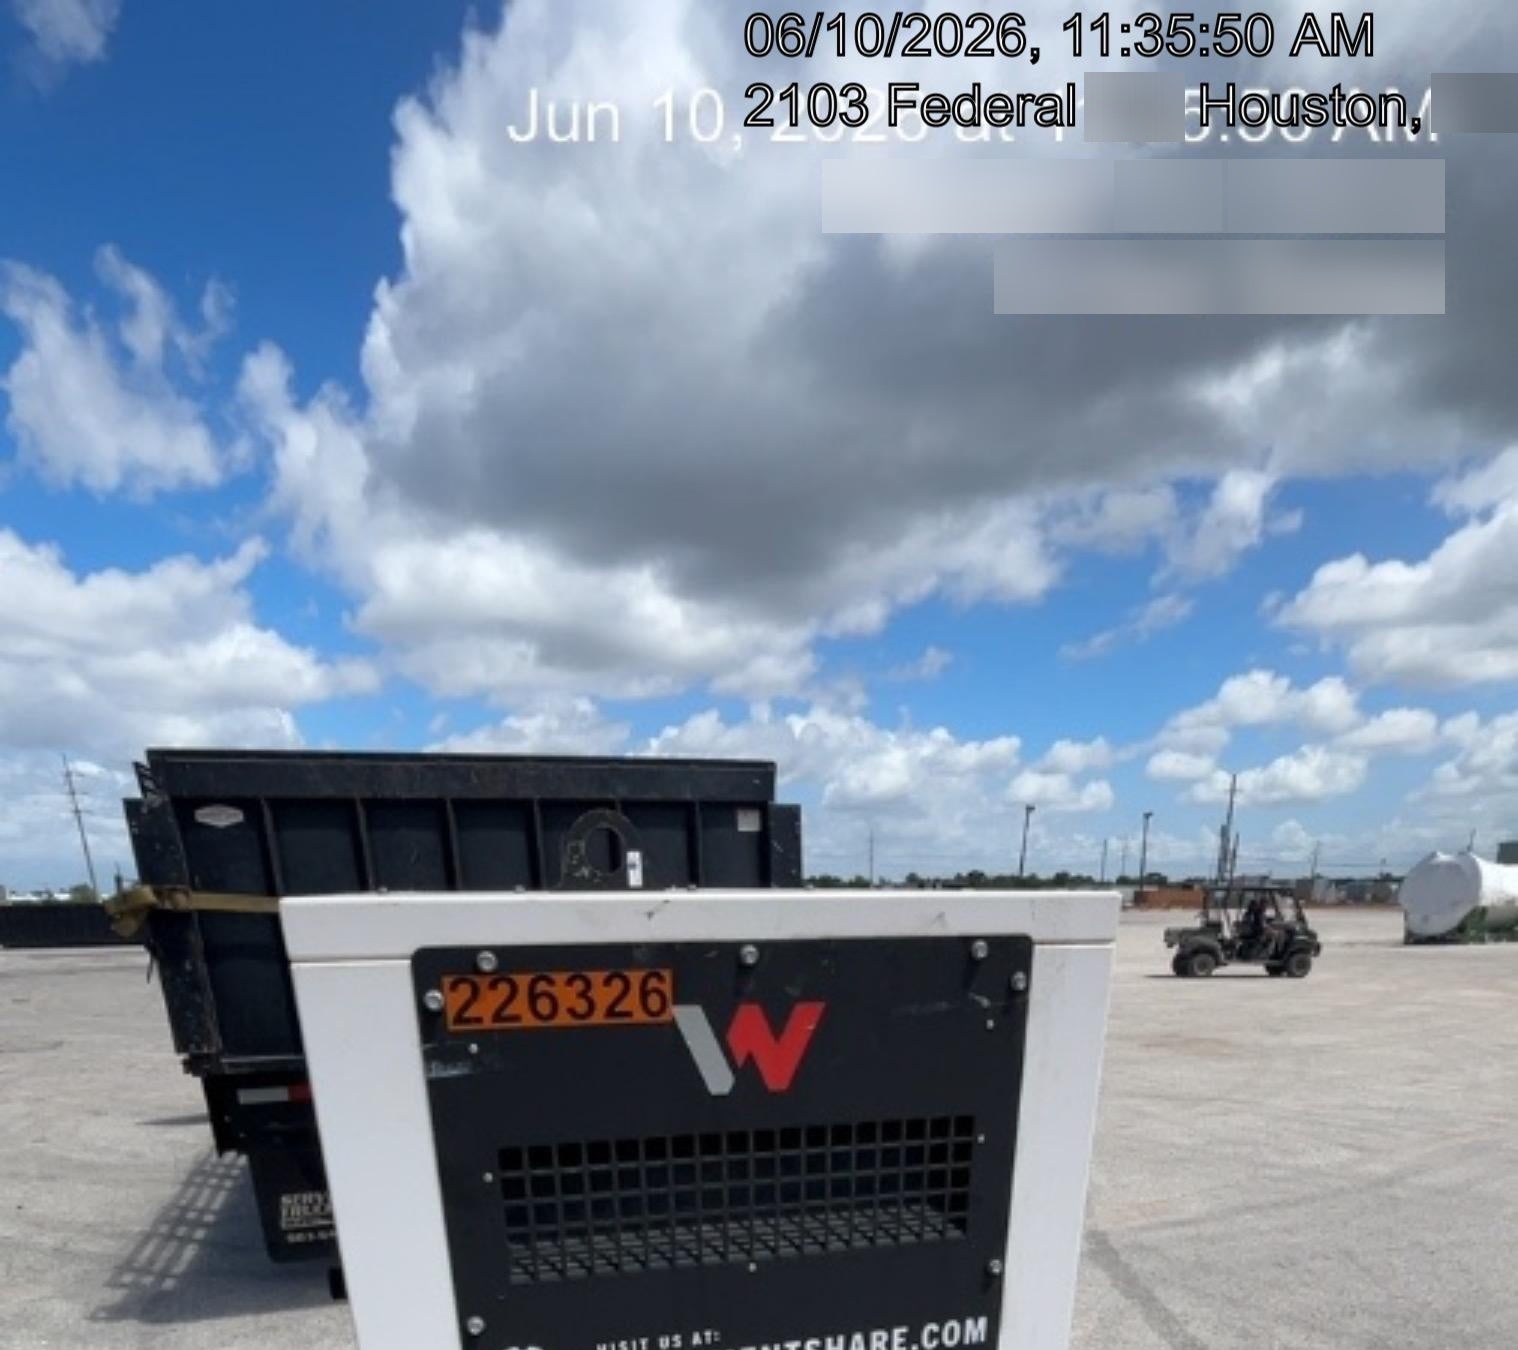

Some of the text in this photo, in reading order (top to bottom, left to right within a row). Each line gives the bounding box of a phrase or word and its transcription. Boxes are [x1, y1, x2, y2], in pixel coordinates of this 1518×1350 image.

[449, 971, 668, 1026] 226326
[659, 1333, 682, 1350] US
[691, 1330, 721, 1346] AT:
